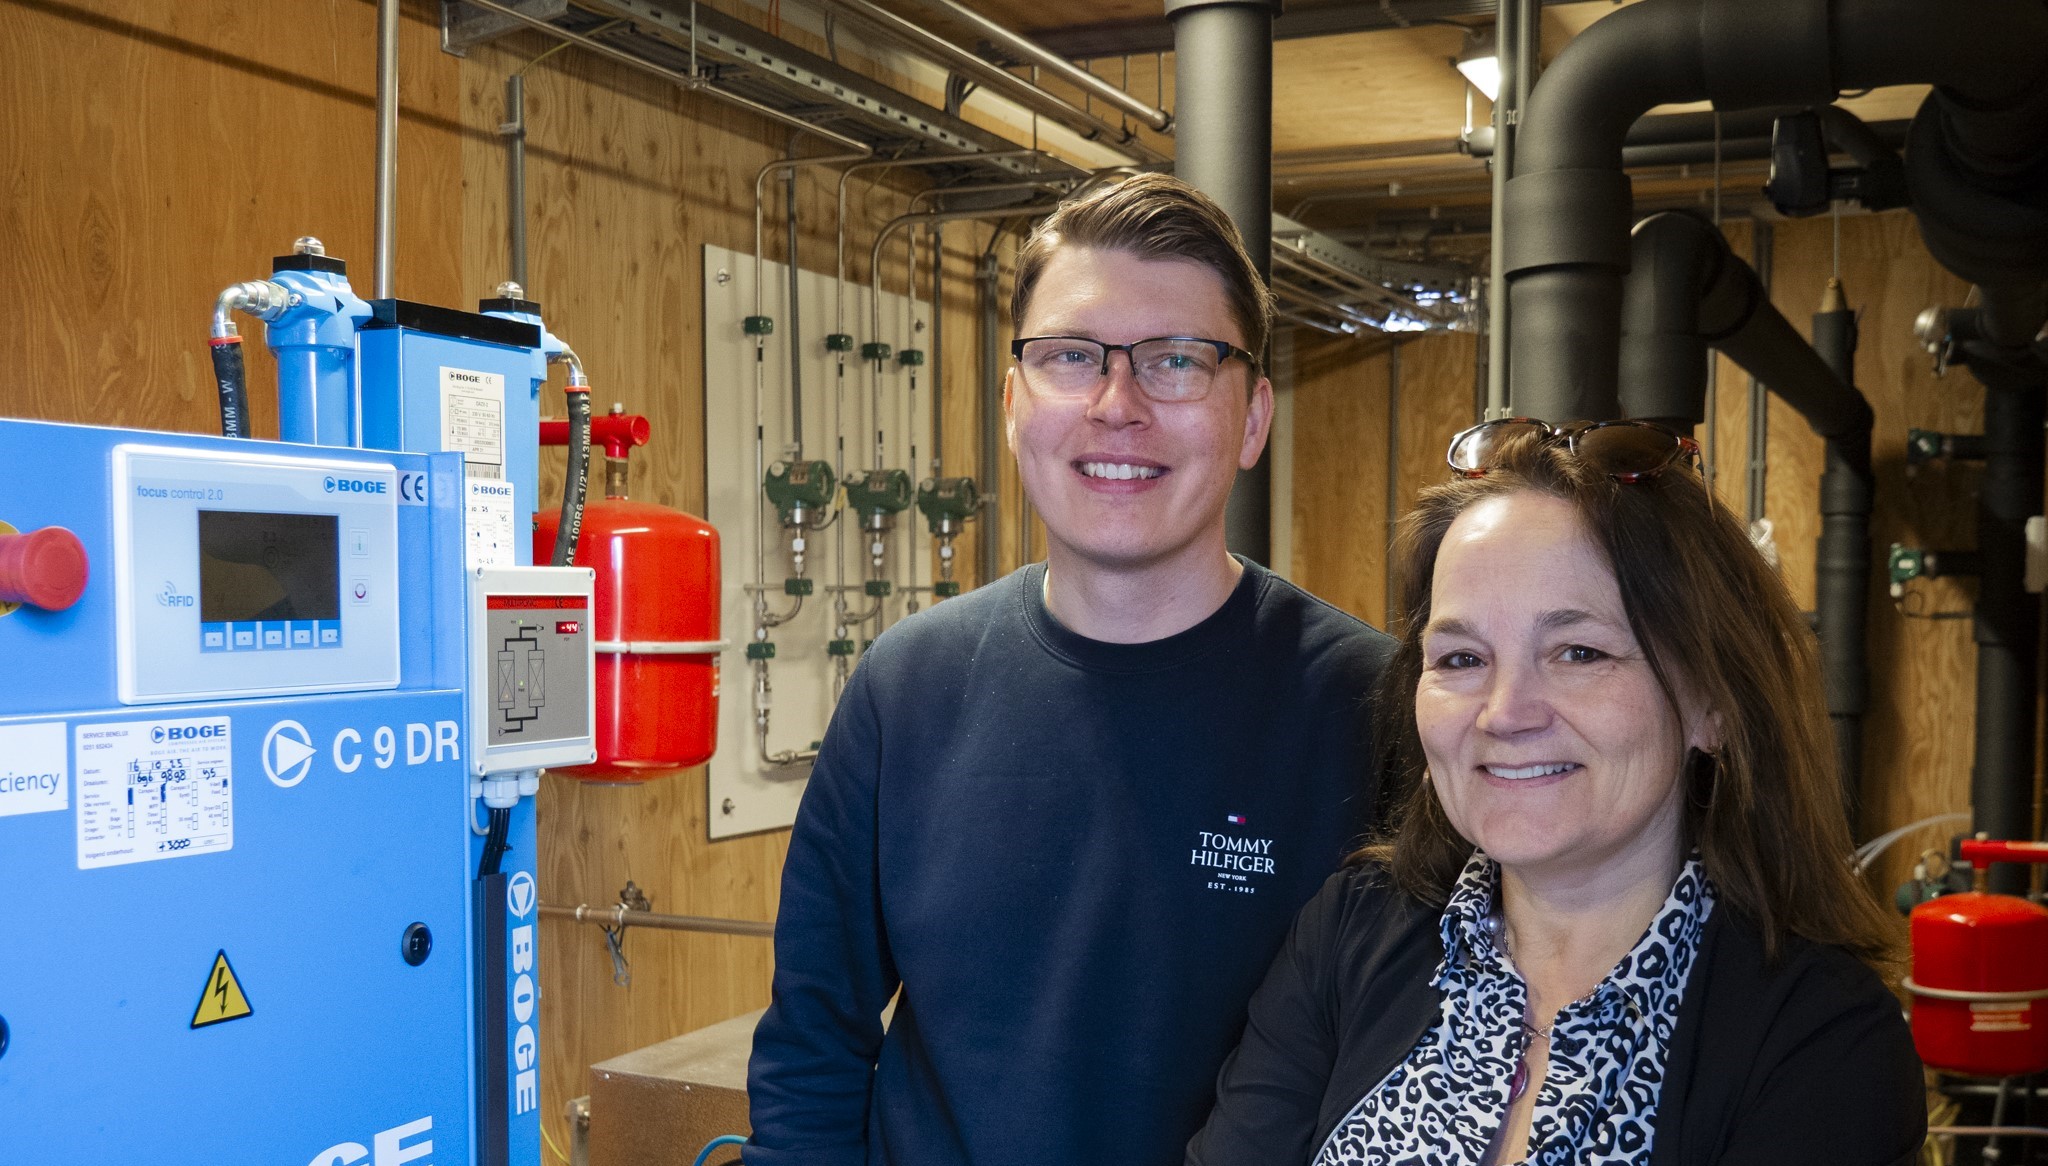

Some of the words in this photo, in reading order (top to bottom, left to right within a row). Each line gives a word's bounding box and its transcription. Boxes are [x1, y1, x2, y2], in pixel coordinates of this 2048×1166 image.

[456, 374, 480, 383] BOGE
[137, 486, 168, 499] focus
[171, 488, 205, 500] control
[208, 489, 224, 500] 2.0
[338, 479, 386, 494] BOGE
[481, 486, 511, 496] BOGE
[565, 547, 576, 567] AE
[572, 504, 584, 541] 100R6
[582, 425, 590, 458] 13MM
[169, 595, 194, 607] RFID
[168, 725, 226, 740] BOGE
[333, 728, 362, 773] C
[374, 726, 396, 769] 9
[406, 720, 460, 766] DR
[0, 772, 60, 795] ciency
[1199, 832, 1273, 855] TOMMY
[1190, 850, 1275, 874] HILFIGER
[512, 924, 537, 1115] BOGE
